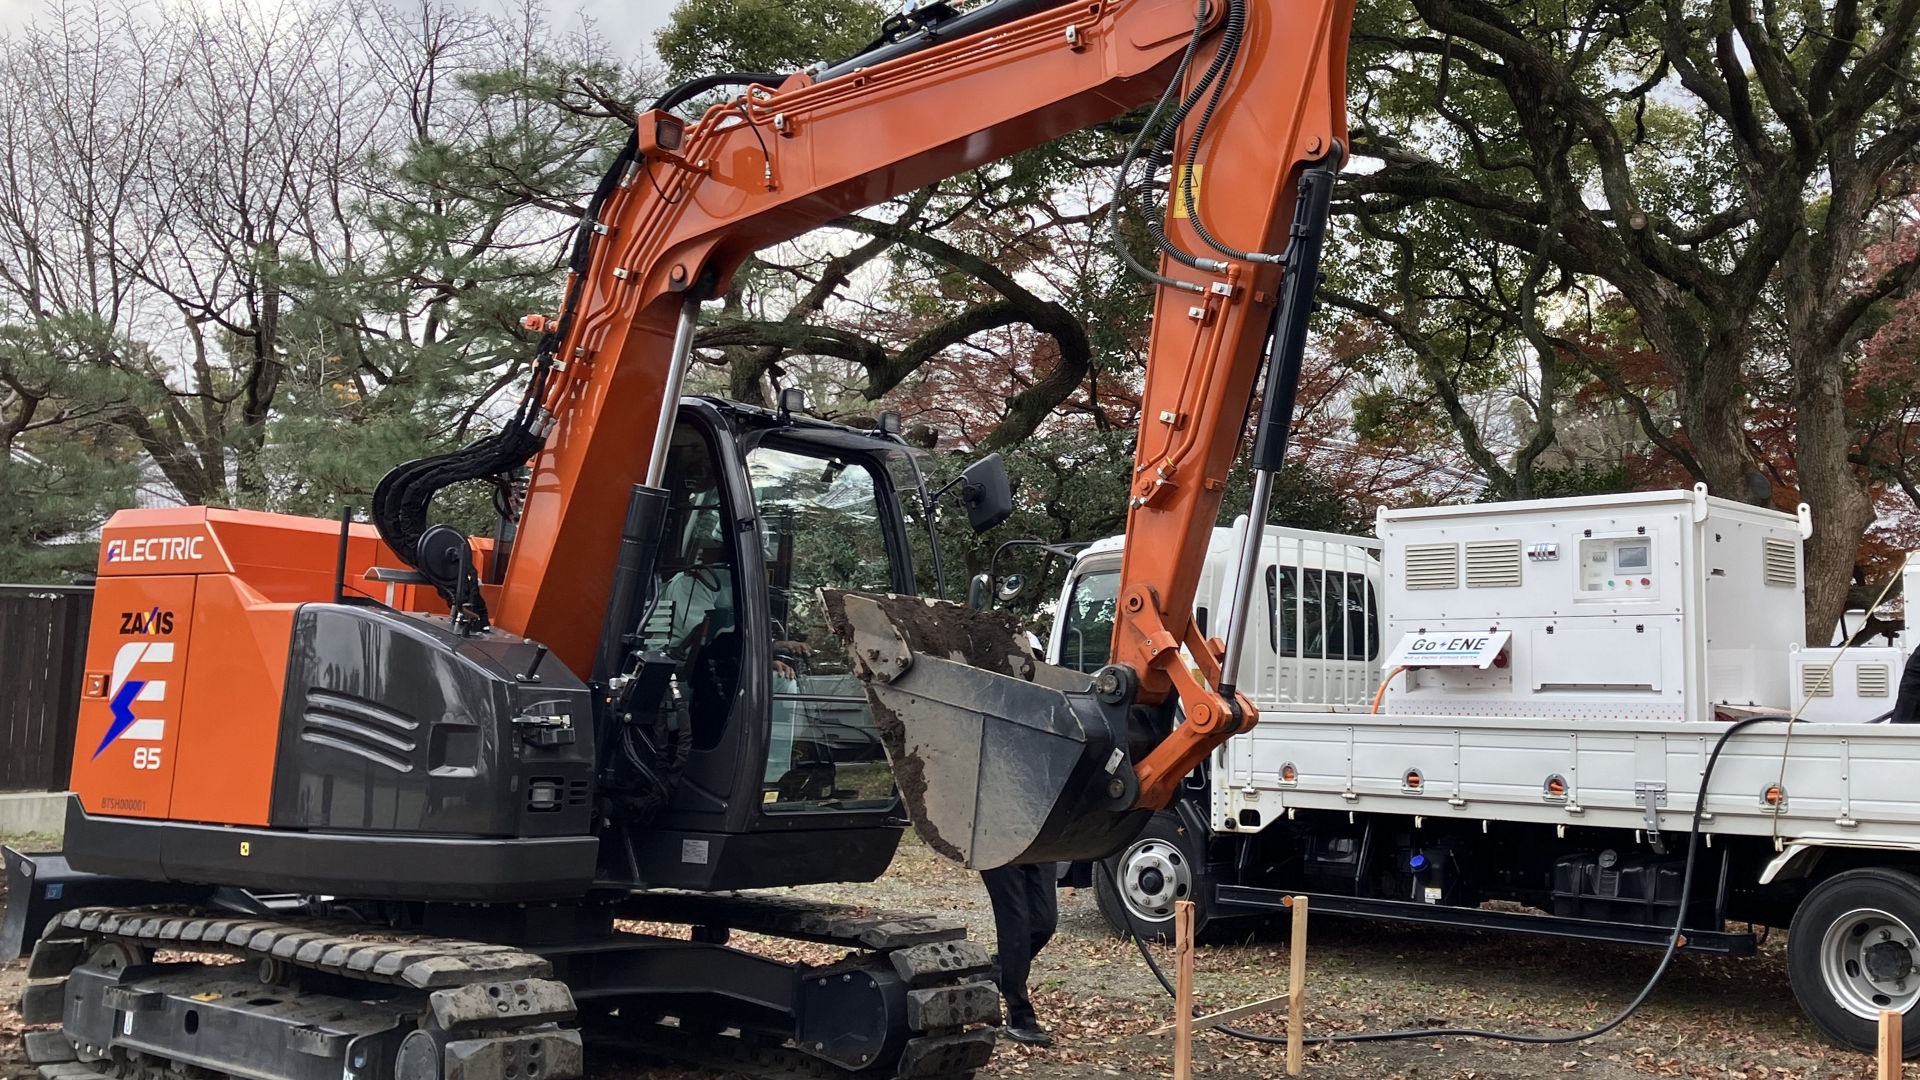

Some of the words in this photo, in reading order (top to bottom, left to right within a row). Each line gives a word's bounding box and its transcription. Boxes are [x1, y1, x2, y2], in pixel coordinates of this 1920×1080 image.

[106, 536, 204, 563] ELECTRIC
[120, 607, 174, 635] ZAXIS
[1412, 638, 1437, 651] Go
[1447, 638, 1489, 651] ENE
[133, 747, 161, 769] 85
